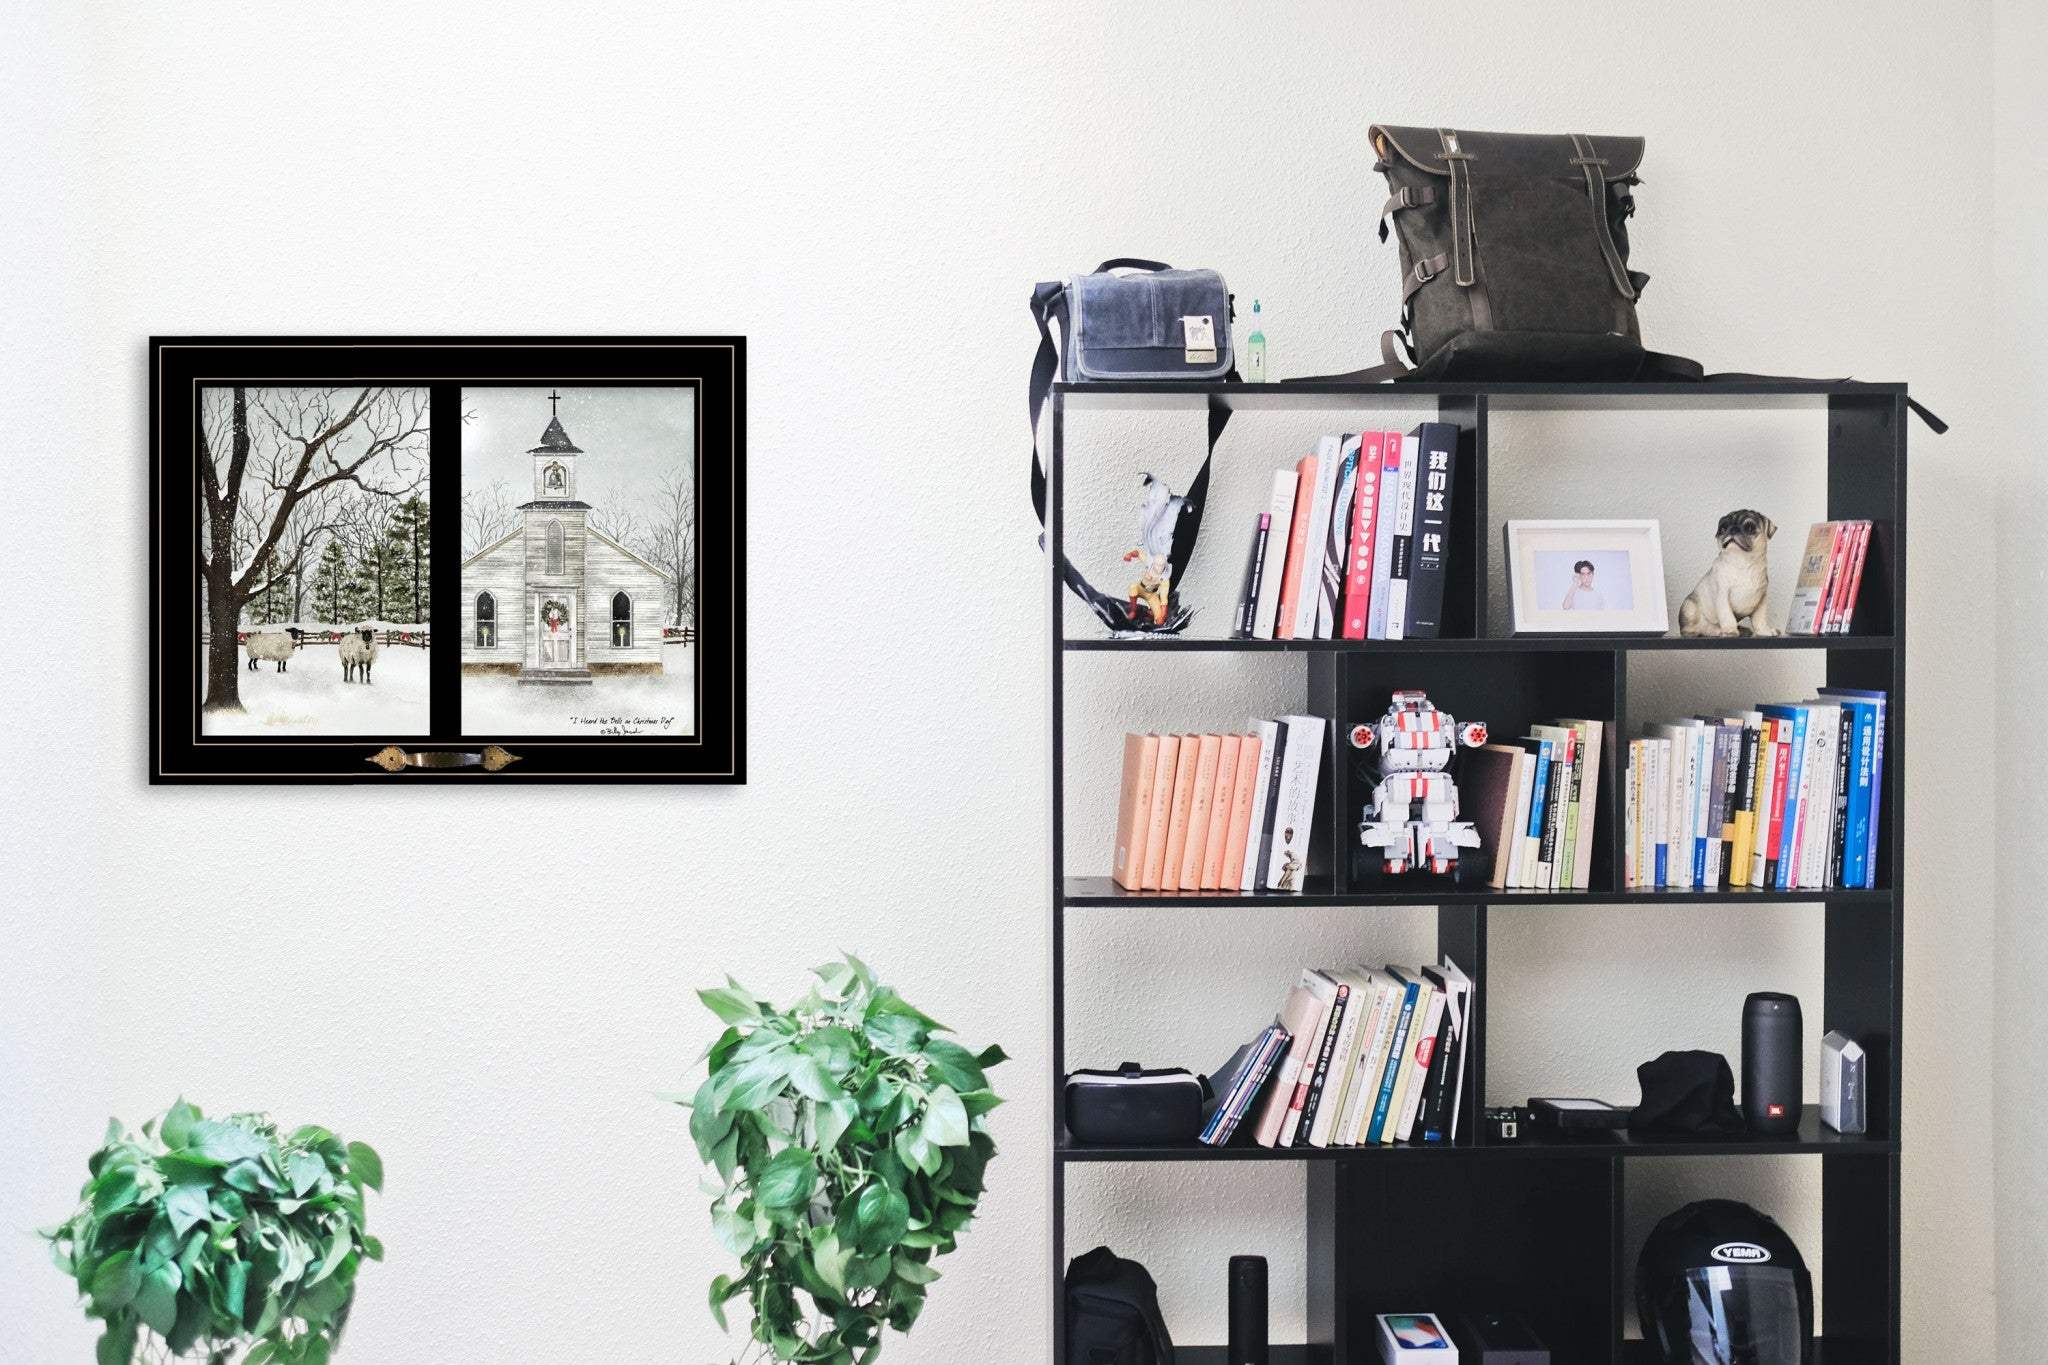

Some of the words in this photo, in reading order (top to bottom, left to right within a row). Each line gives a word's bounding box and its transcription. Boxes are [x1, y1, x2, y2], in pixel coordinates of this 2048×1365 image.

[1423, 450, 1448, 552] 我们这一代
[633, 717, 658, 725] Christmas
[1859, 725, 1872, 787] 通用设计法则
[1723, 1248, 1760, 1258] YEMA
